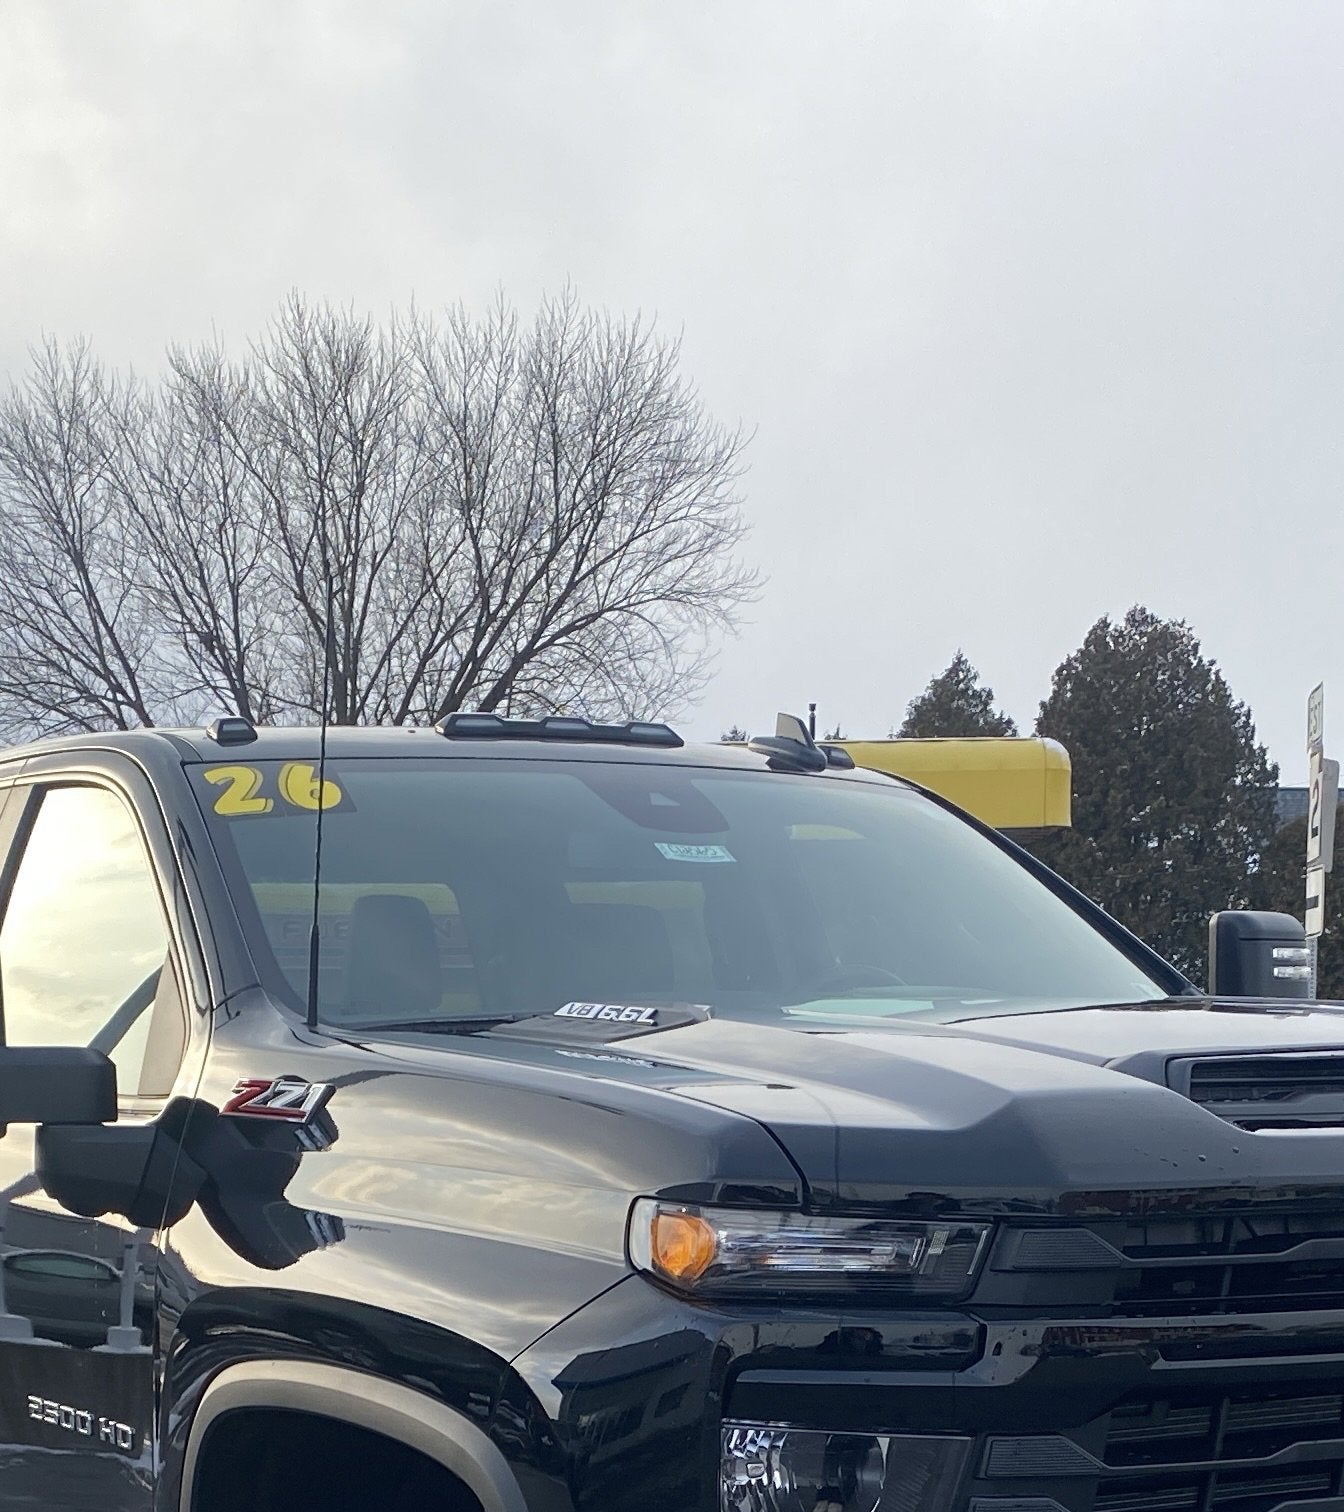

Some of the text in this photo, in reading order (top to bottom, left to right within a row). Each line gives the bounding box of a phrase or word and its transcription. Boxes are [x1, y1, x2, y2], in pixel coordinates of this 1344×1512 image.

[204, 763, 342, 816] 26
[597, 1004, 657, 1025] 6.6L
[221, 1077, 332, 1123] Z71
[27, 1394, 135, 1451] 2500 HD
